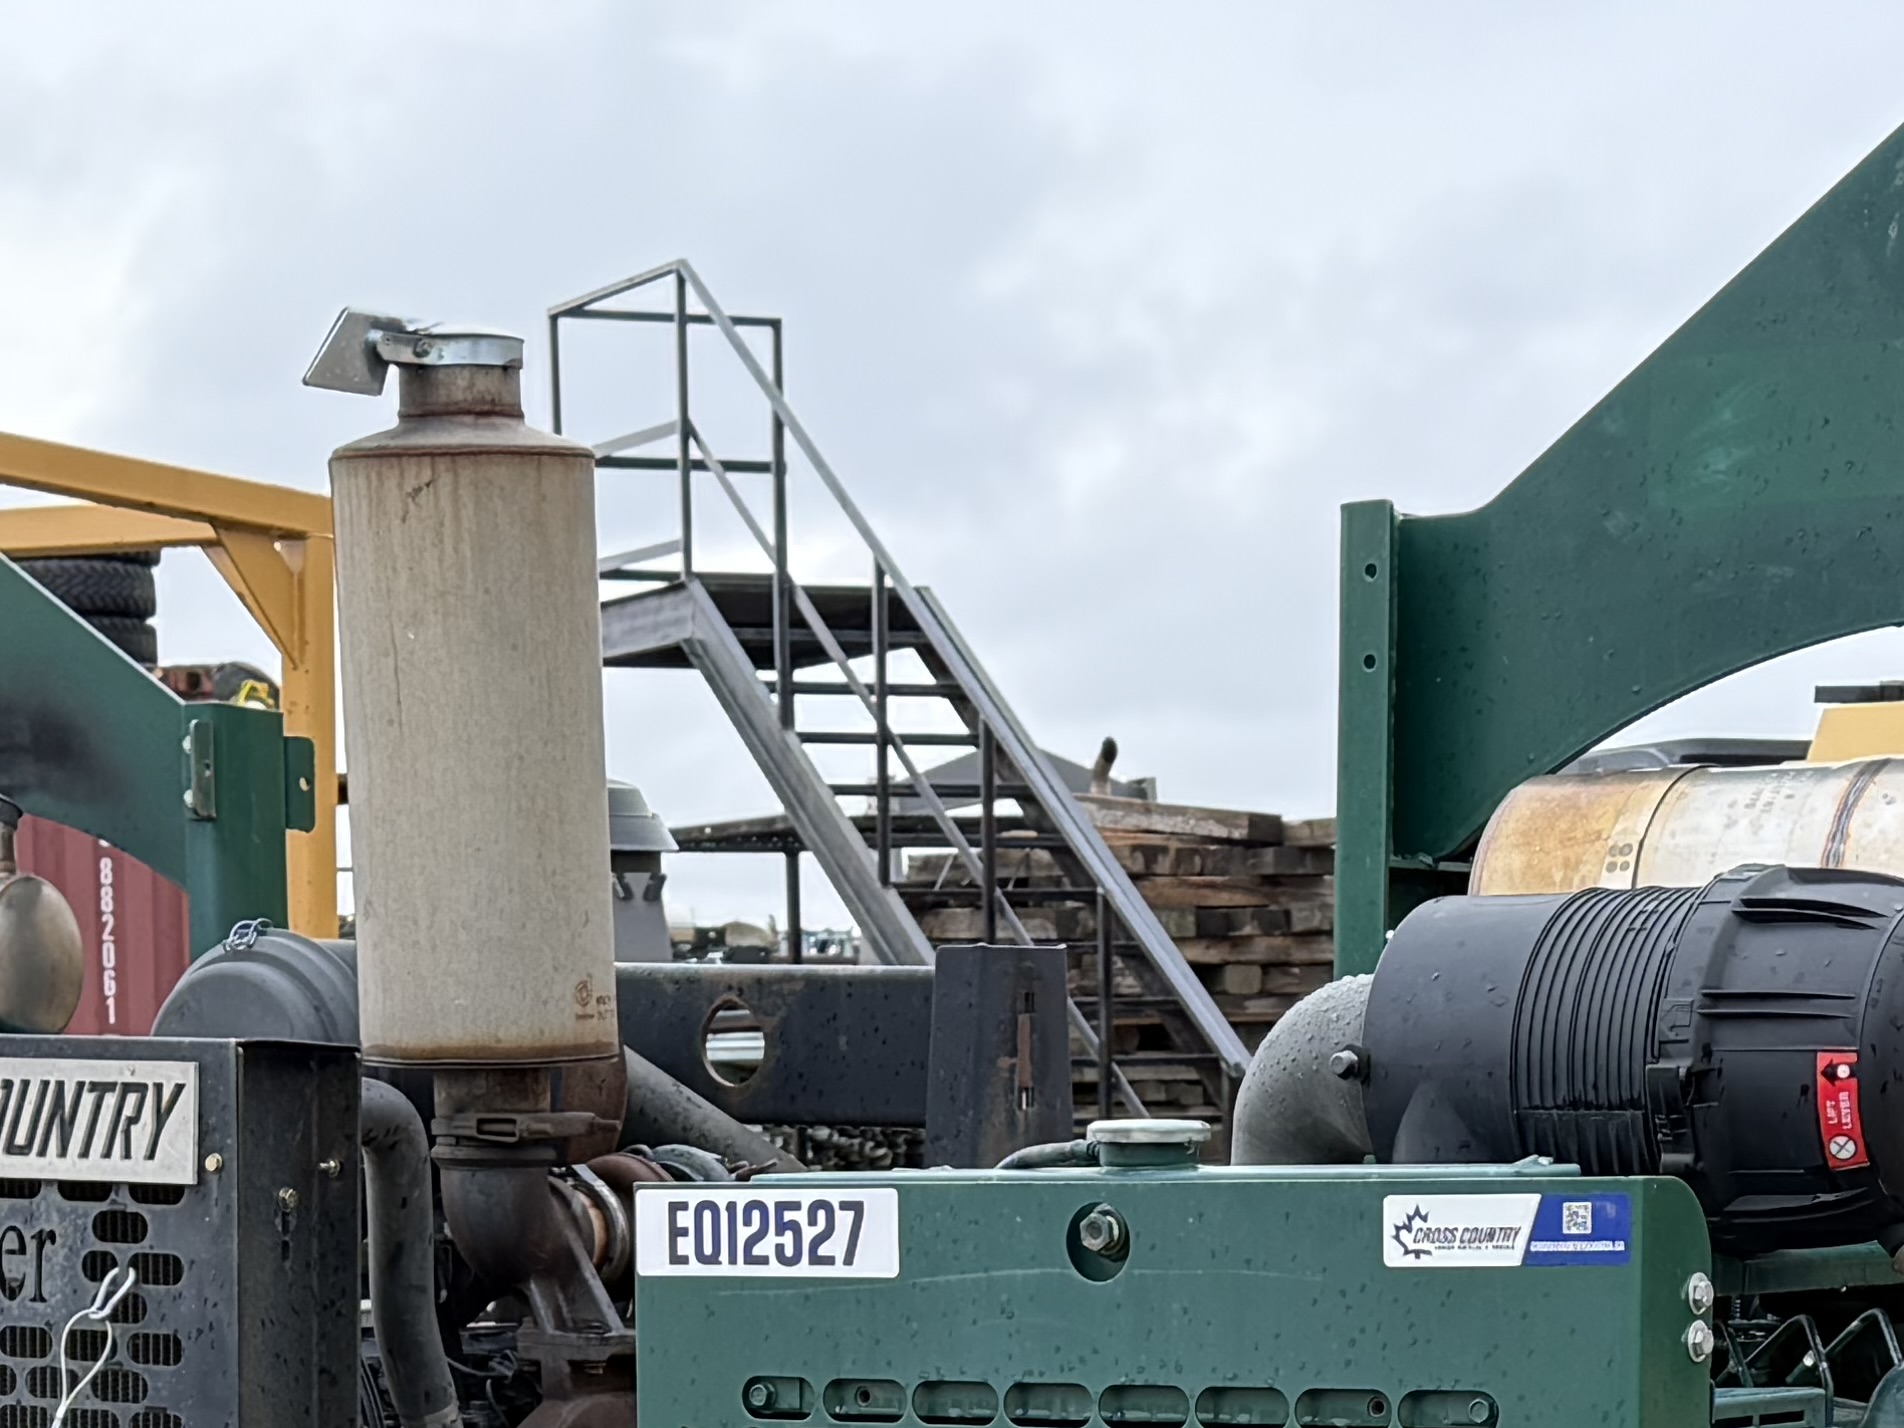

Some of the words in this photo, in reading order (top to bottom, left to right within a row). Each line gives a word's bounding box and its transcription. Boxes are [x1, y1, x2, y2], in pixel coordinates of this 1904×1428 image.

[667, 1199, 866, 1270] EQ12527
[1412, 1226, 1459, 1246] CROSS
[1459, 1225, 1522, 1244] COUNTRY
